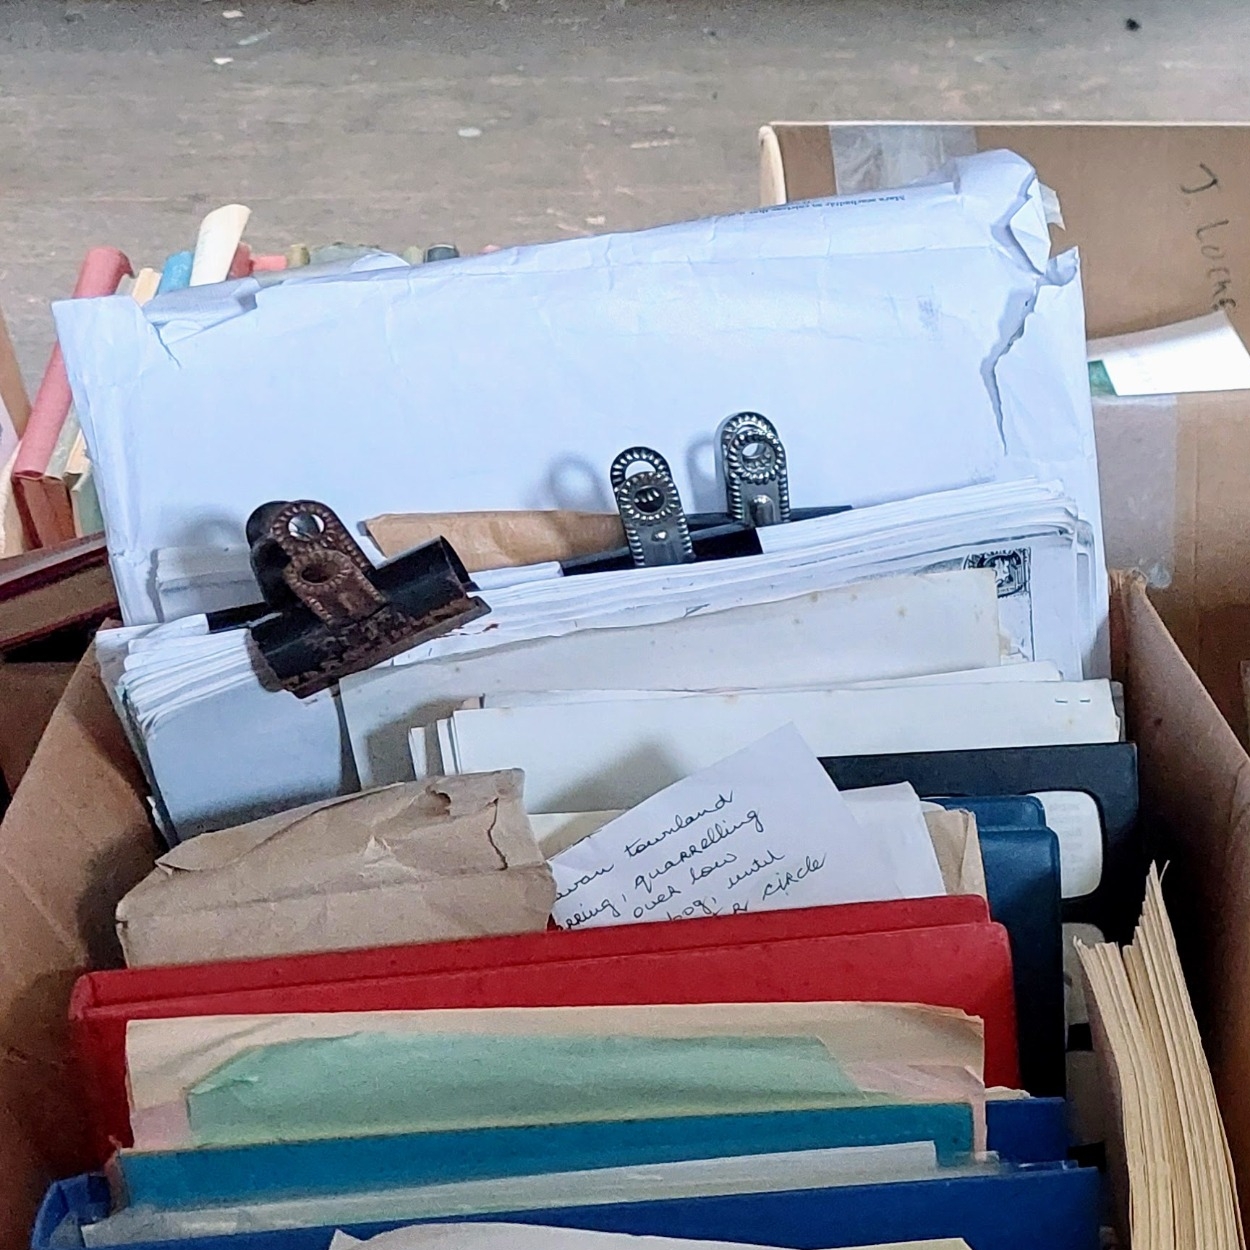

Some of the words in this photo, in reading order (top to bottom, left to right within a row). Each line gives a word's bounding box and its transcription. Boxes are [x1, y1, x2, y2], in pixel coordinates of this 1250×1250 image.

[624, 790, 733, 859] townland
[690, 852, 738, 885] low
[727, 849, 785, 890] until
